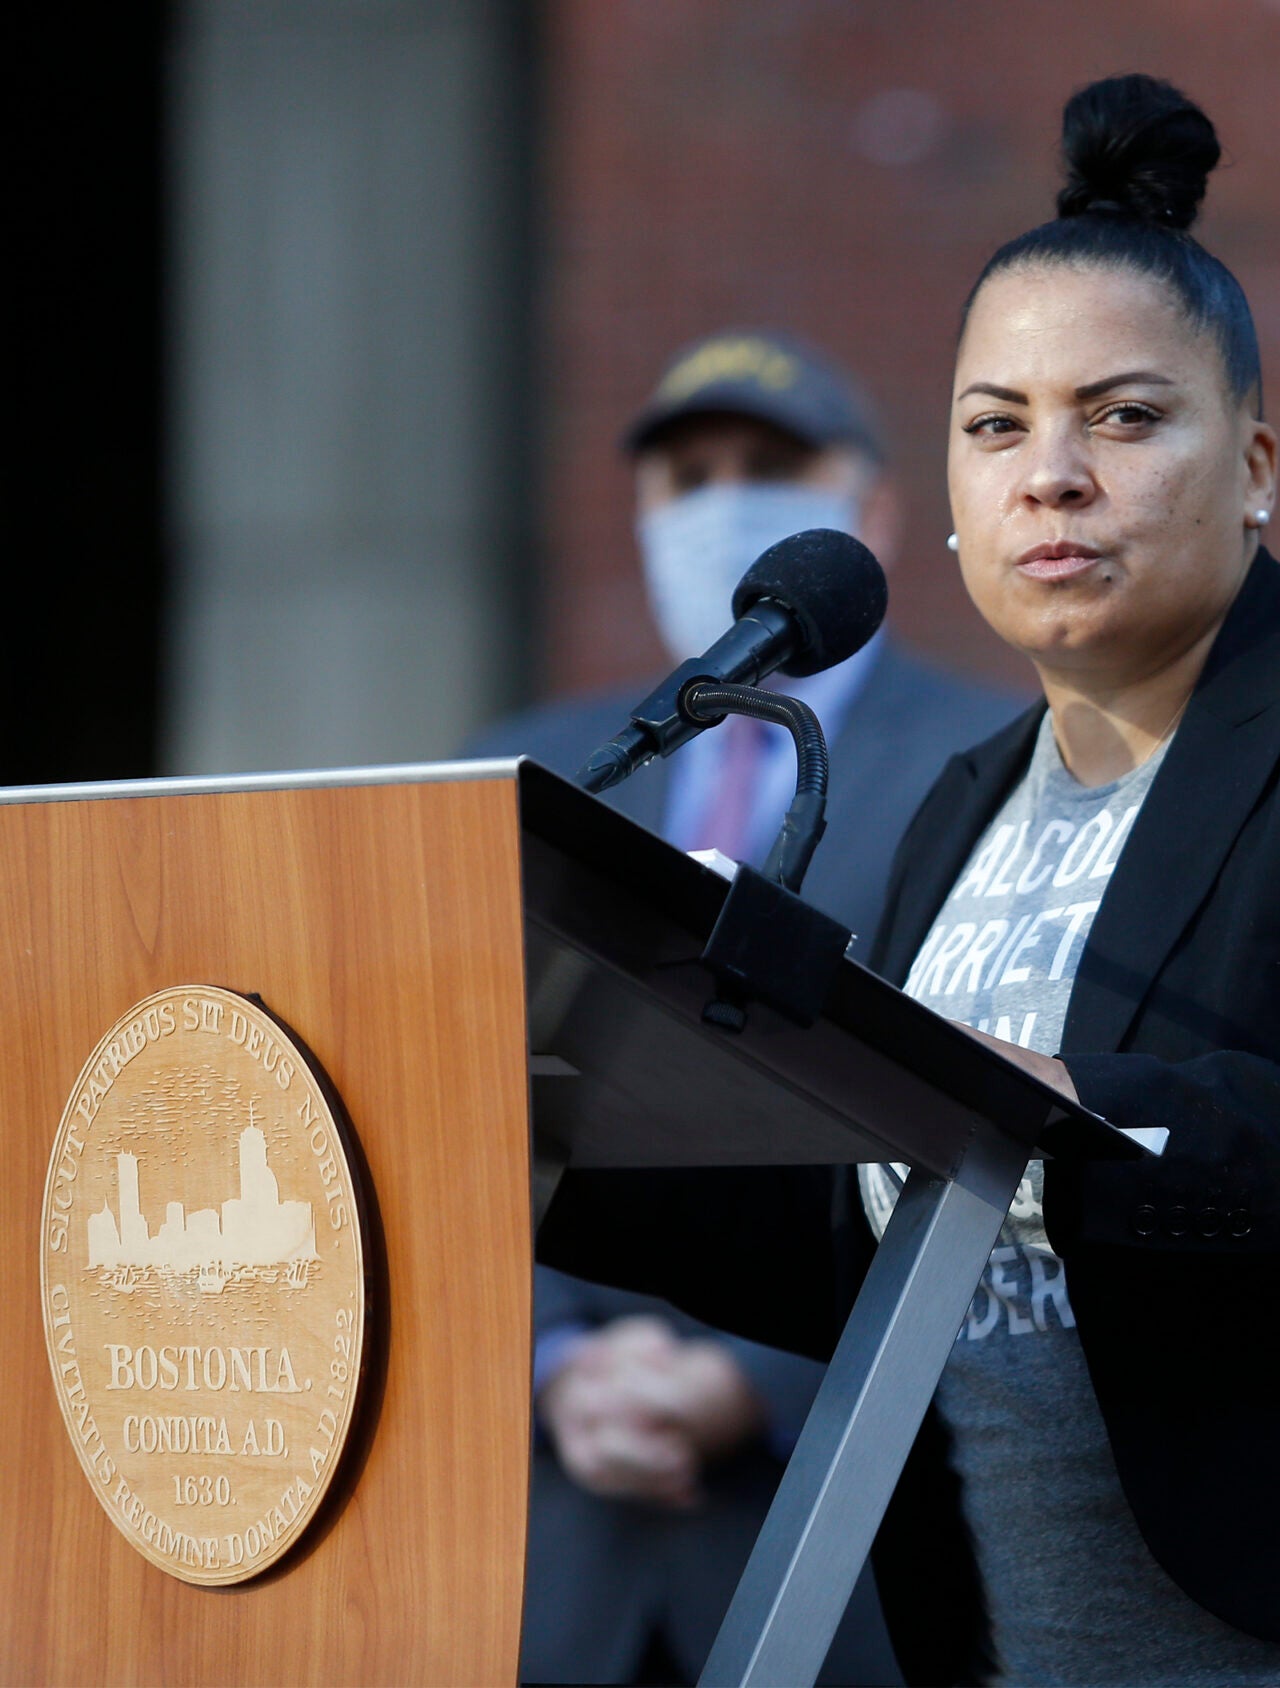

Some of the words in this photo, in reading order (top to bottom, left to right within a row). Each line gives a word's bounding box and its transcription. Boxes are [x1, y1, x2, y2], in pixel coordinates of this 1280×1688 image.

[50, 1123, 86, 1254] SICUT
[76, 1002, 177, 1131] PATRIBUS
[183, 998, 225, 1035] SIT
[227, 1010, 295, 1091] DEUS
[957, 1243, 1077, 1341] DER
[103, 1343, 314, 1394] BOSTONIA.
[51, 1284, 117, 1486] CIVITATIS
[224, 1474, 315, 1568] DONATA
[122, 1415, 237, 1456] CONDITA
[172, 1474, 239, 1507] 1630.
